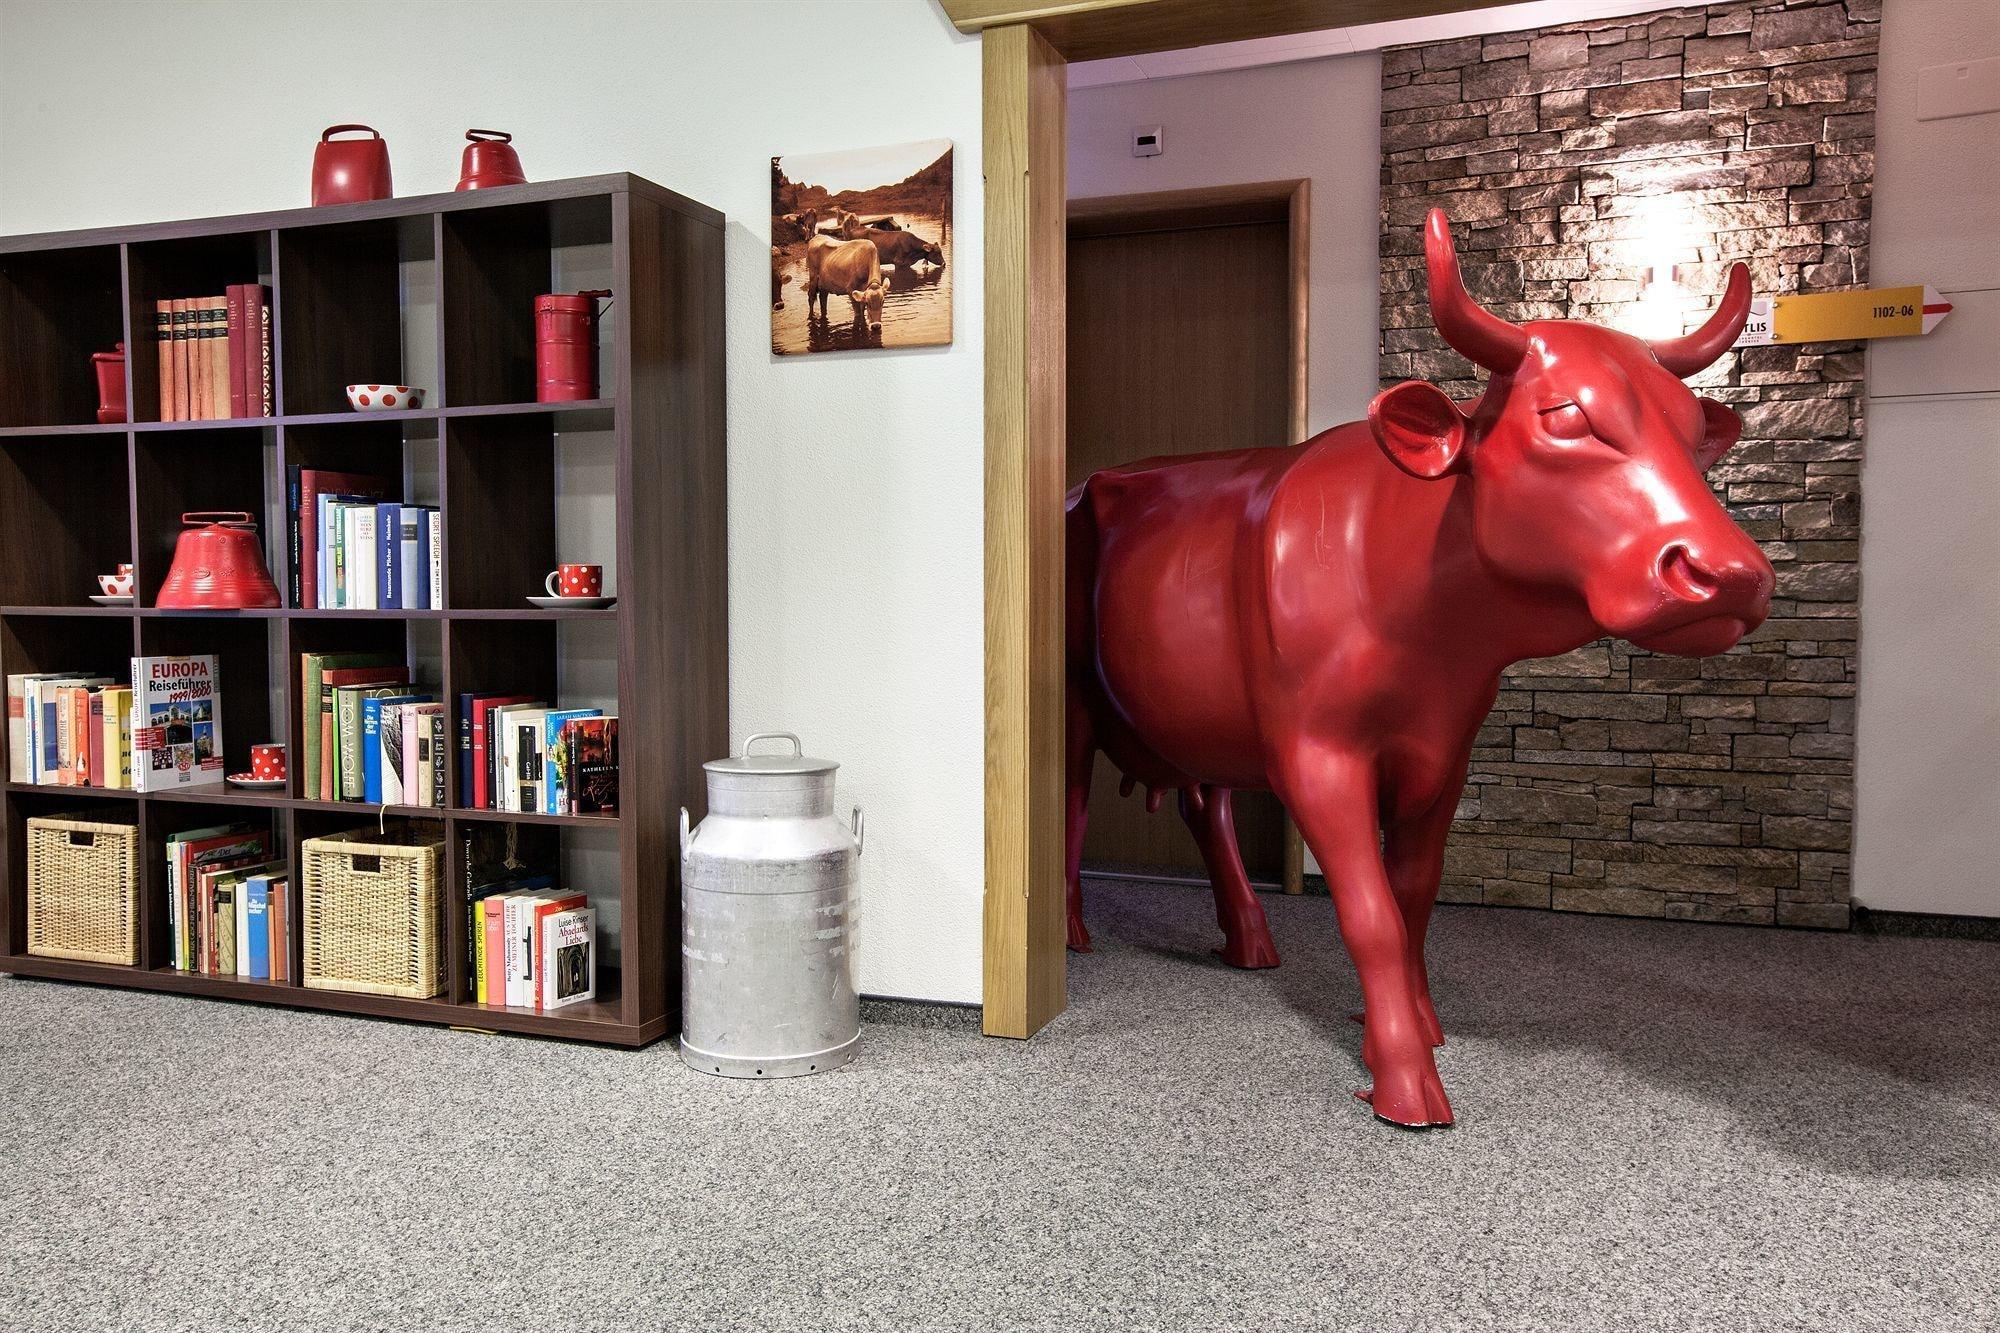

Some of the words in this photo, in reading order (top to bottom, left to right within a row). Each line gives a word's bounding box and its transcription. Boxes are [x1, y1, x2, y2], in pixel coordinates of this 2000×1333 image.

[1873, 305, 1914, 318] 1102-06
[152, 661, 208, 678] EUROPA
[149, 678, 212, 692] Reiseführer
[169, 686, 212, 703] 1999/2000
[341, 701, 354, 738] TOM
[558, 917, 572, 928] Luise
[572, 915, 589, 925] Rinser
[565, 935, 582, 945] Liebe
